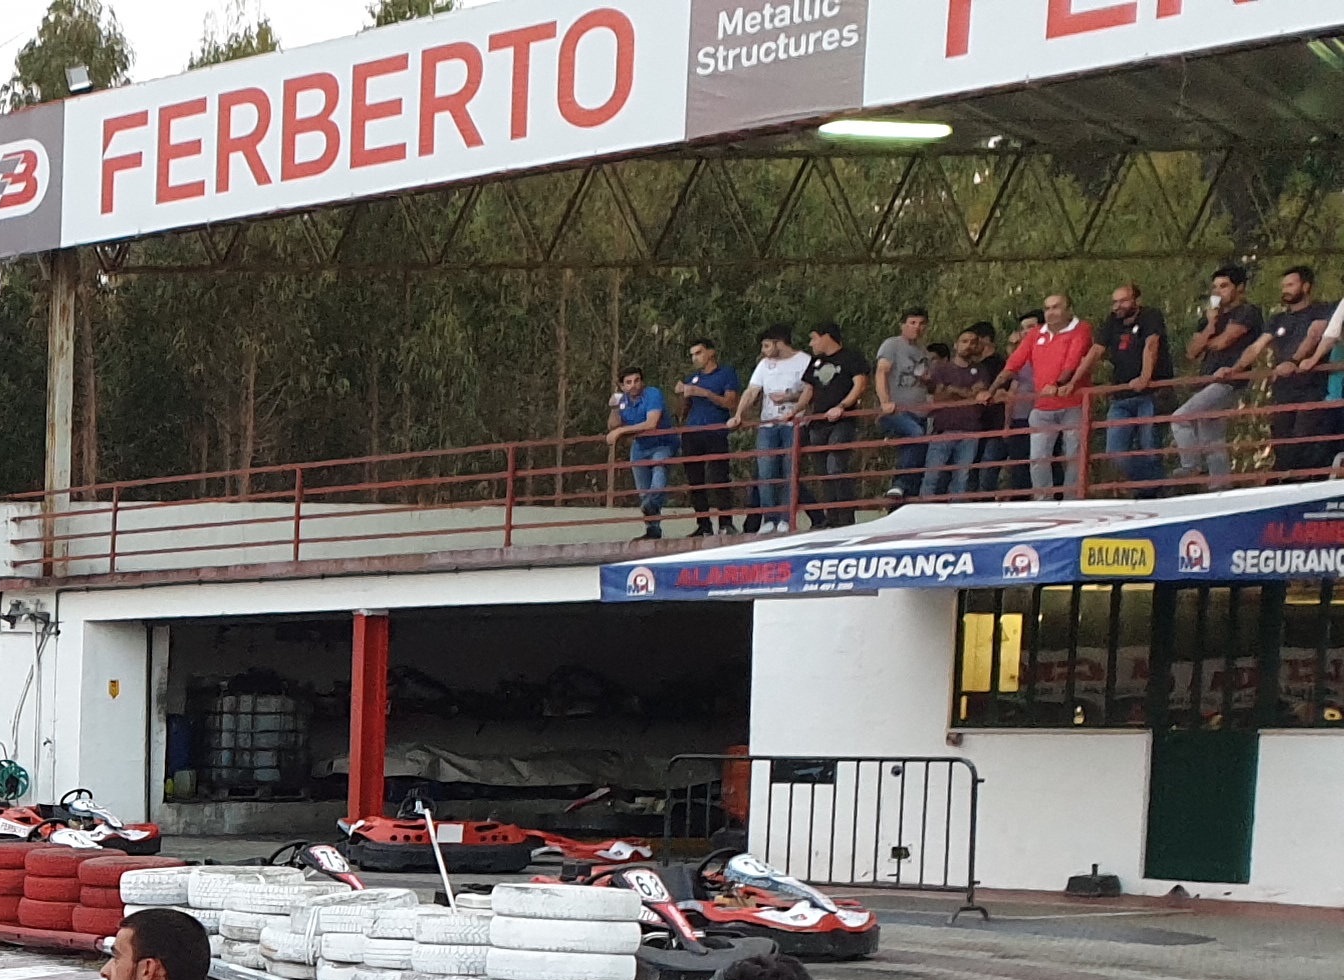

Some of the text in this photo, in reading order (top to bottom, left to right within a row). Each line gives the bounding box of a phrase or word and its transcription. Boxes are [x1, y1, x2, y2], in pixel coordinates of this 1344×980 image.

[718, 0, 841, 41] Metallic
[696, 22, 859, 77] Structures
[99, 8, 634, 215] FERBERTO
[675, 551, 974, 588] ALARMES SEGURANÇA
[1087, 545, 1147, 572] BALANÇA
